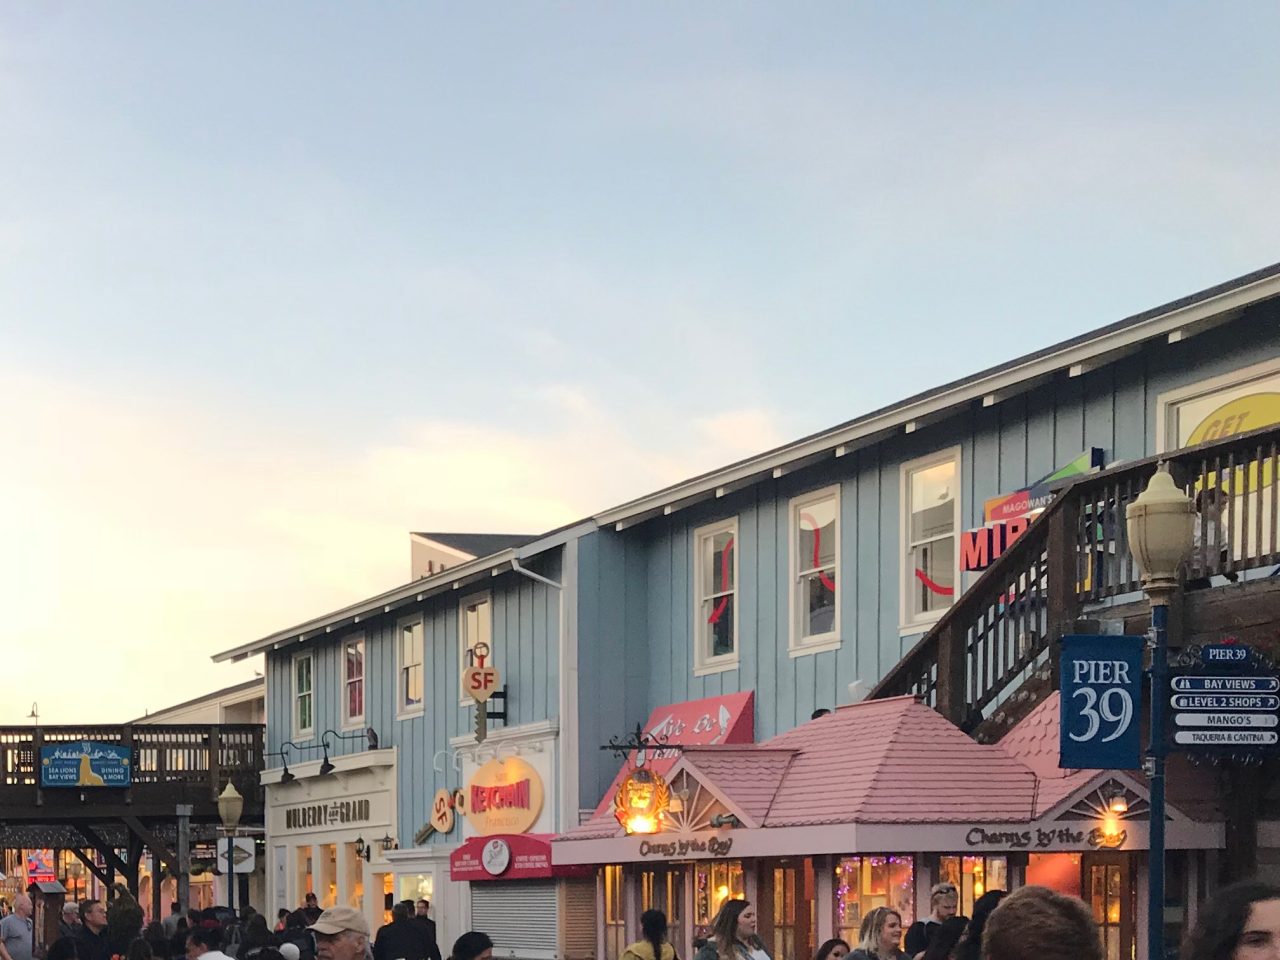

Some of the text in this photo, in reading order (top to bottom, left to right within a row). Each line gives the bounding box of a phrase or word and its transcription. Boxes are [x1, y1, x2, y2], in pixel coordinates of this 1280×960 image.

[1002, 495, 1053, 514] MAGOWAN'S
[1208, 649, 1247, 660] PIER 39
[470, 671, 494, 690] SF
[1073, 660, 1131, 684] PIER
[1204, 680, 1256, 689] BAY VIEWS
[1189, 697, 1261, 707] LEVEL 2 SHOPS
[1069, 687, 1133, 742] 39
[1207, 716, 1252, 725] MANGO'S
[1192, 733, 1225, 741] TAQUERIA
[470, 778, 530, 814] KEYCHAIN
[286, 804, 328, 829] MULBERRY
[339, 799, 370, 823] GRAND
[435, 797, 448, 825] SF
[966, 827, 1031, 848] Charms
[1034, 828, 1055, 847] by
[1056, 828, 1084, 844] the
[639, 840, 676, 857] Charms
[689, 838, 707, 852] the
